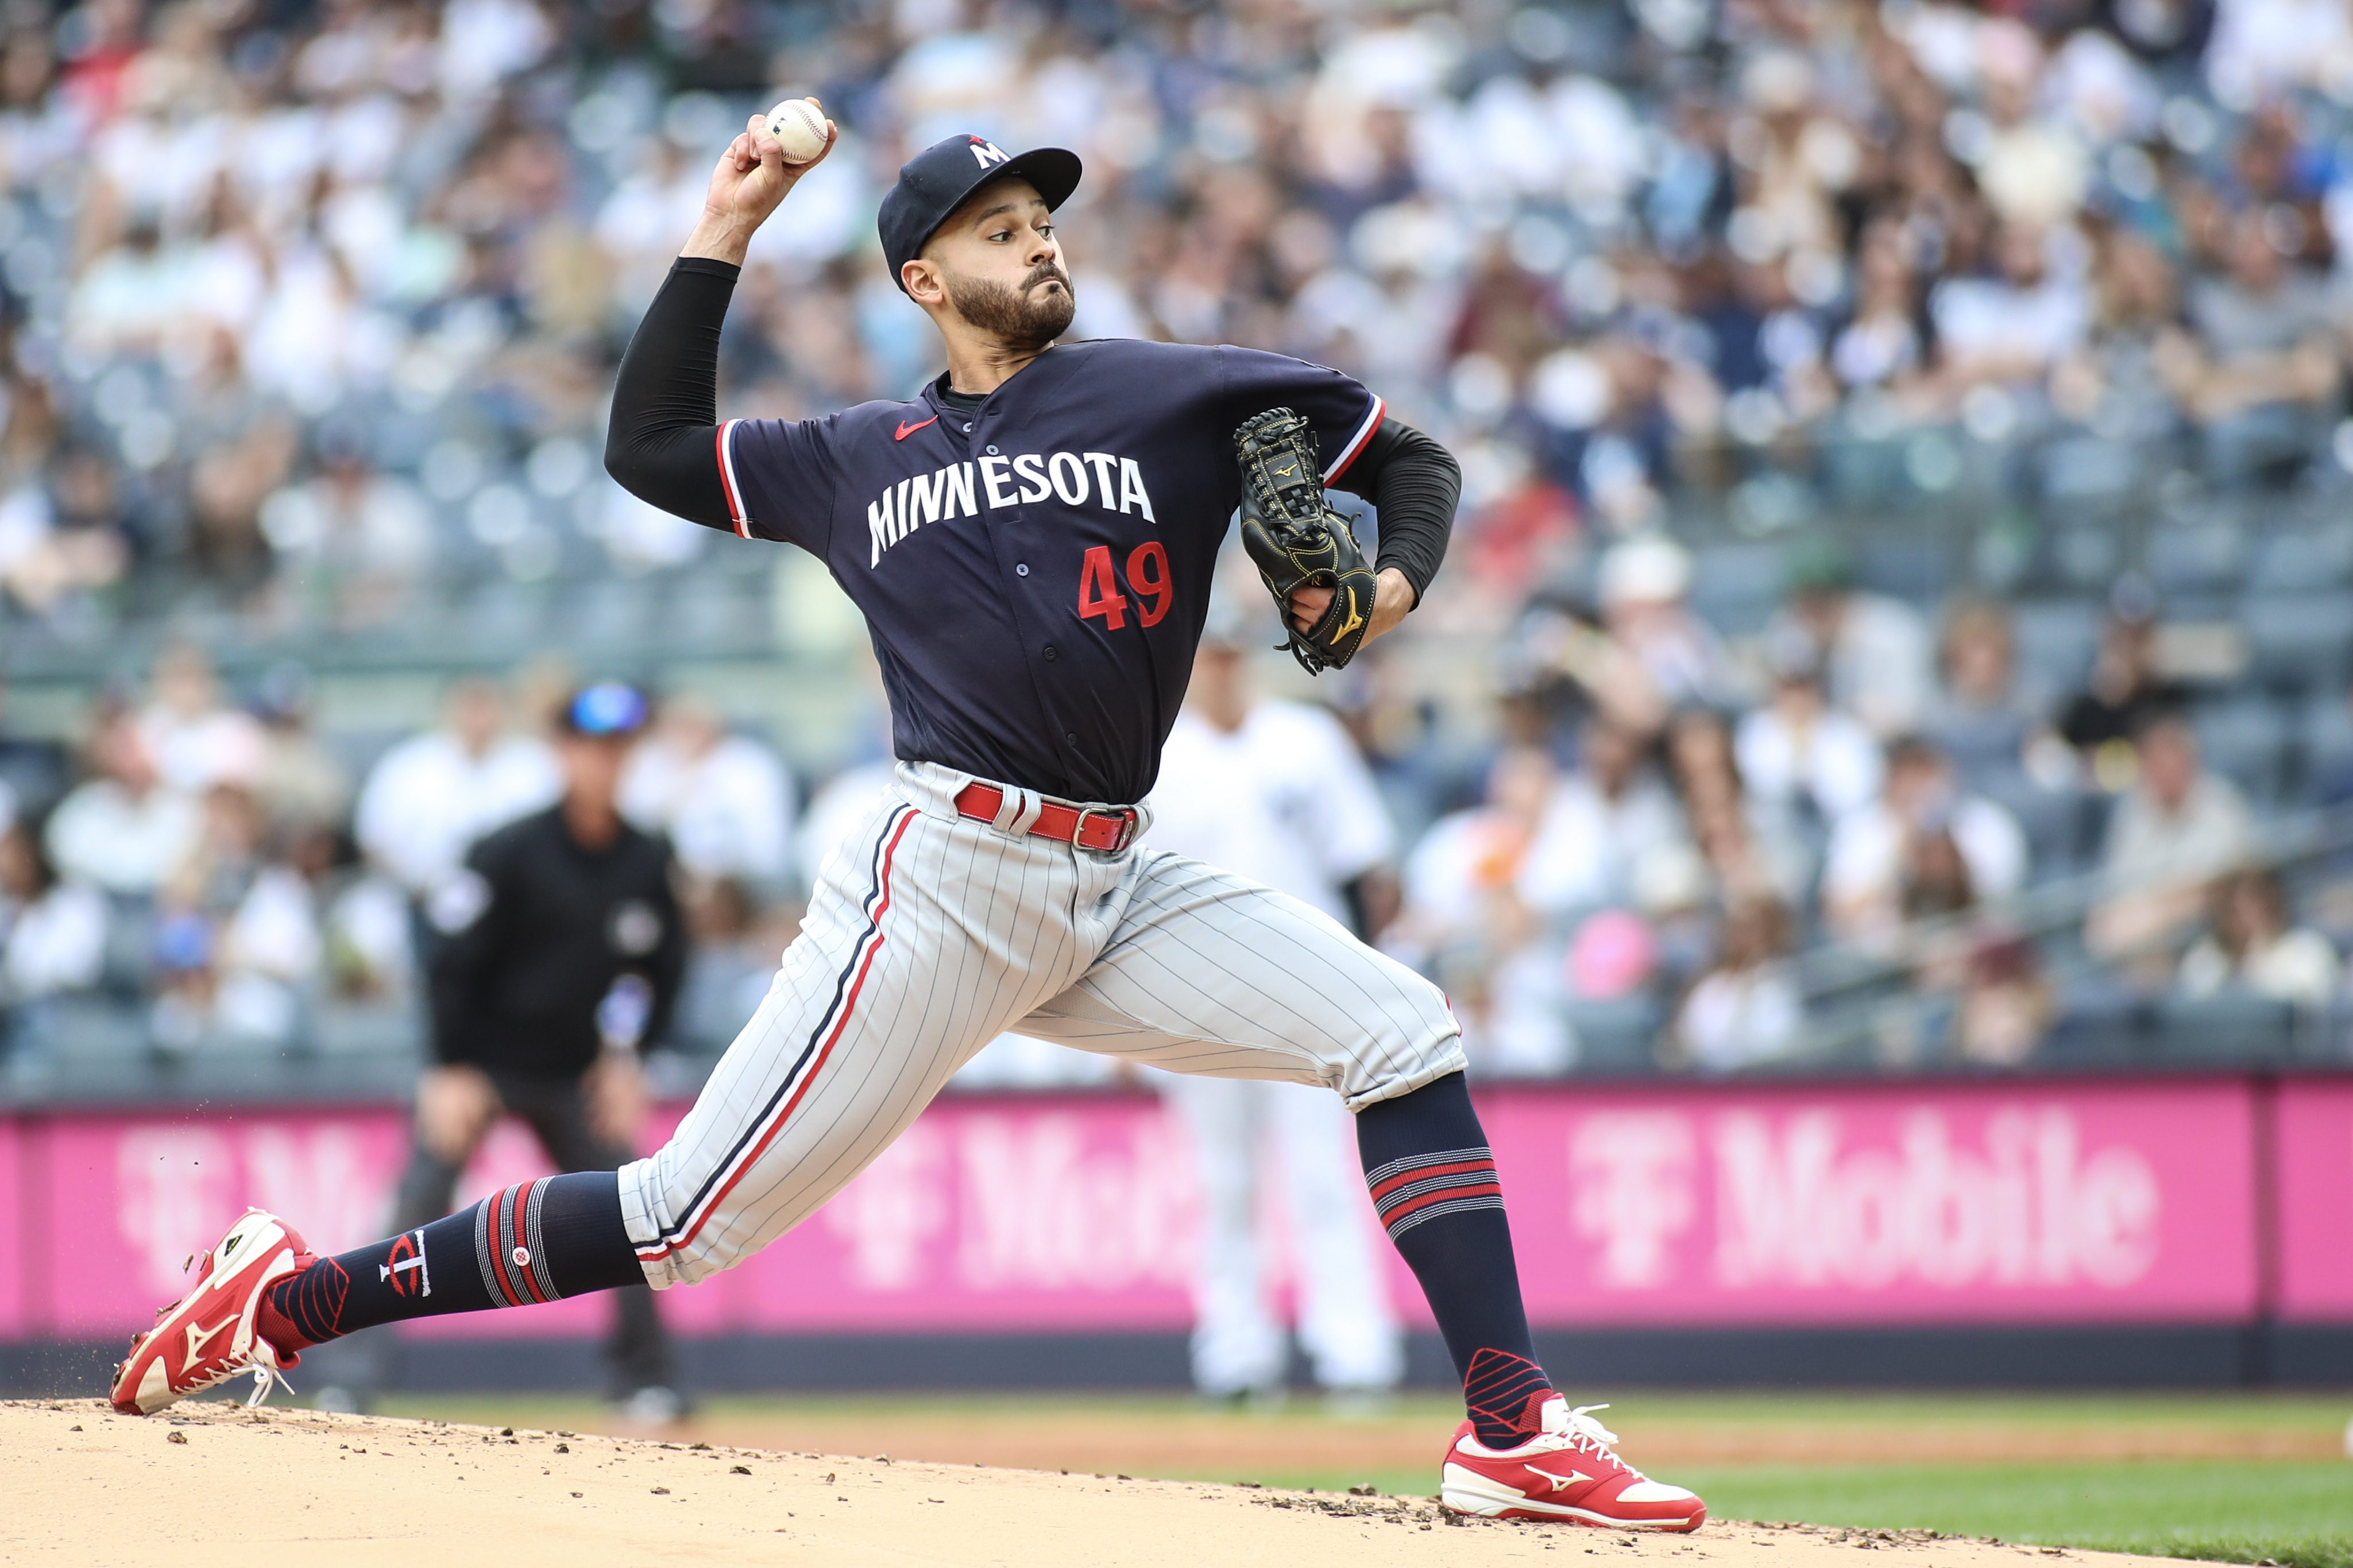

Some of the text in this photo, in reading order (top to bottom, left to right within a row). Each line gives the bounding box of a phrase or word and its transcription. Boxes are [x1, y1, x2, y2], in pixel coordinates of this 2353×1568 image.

[969, 142, 1011, 170] M
[868, 451, 1156, 570] MINNESOTA
[1077, 541, 1173, 631] 49
[1714, 1107, 2161, 1290] Mobile
